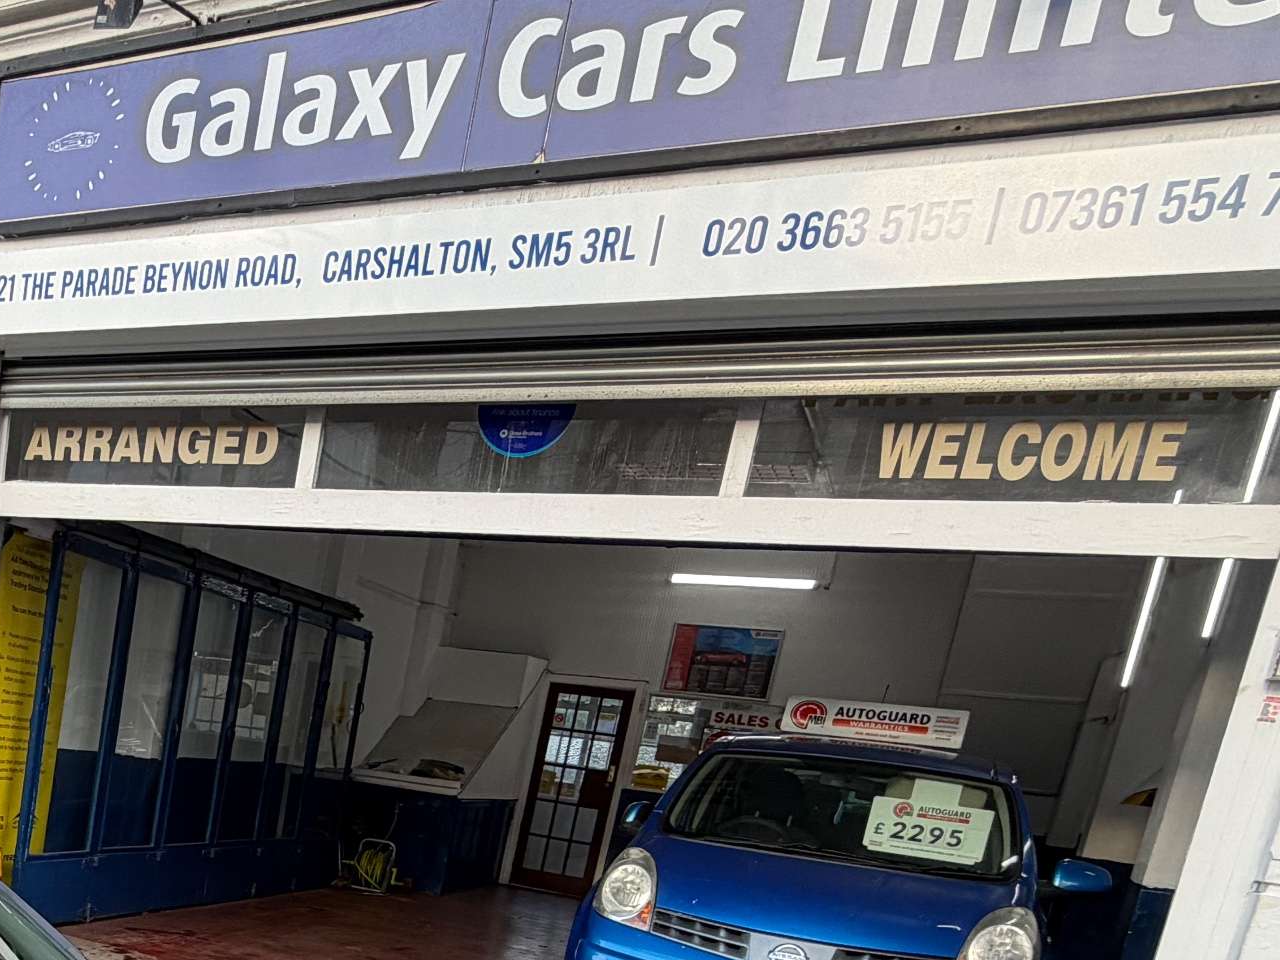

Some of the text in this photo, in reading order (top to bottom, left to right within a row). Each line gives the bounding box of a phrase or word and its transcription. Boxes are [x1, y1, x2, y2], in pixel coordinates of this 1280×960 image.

[145, 52, 466, 164] Galaxy
[498, 18, 743, 118] Cars
[22, 271, 56, 301] THE
[60, 265, 138, 299] PARADE
[142, 258, 229, 294] BEYNON
[235, 253, 301, 289] ROAD,
[322, 238, 497, 284] CARSHALTON,
[508, 230, 573, 270] SM5
[580, 225, 636, 264] 3RL
[702, 215, 769, 257] 020
[776, 207, 870, 252] 3663
[879, 198, 973, 245] 5155
[1018, 182, 1149, 234] 07361
[1158, 173, 1250, 225] 554
[24, 425, 280, 466] ARRANGED
[878, 420, 1188, 483] WELCOME
[714, 712, 769, 729] SALES
[834, 705, 931, 726] AUTOGUARD
[849, 720, 910, 733] WARRANTIES
[918, 805, 972, 820] AUTOGUARD
[873, 821, 964, 848] £ 2295
